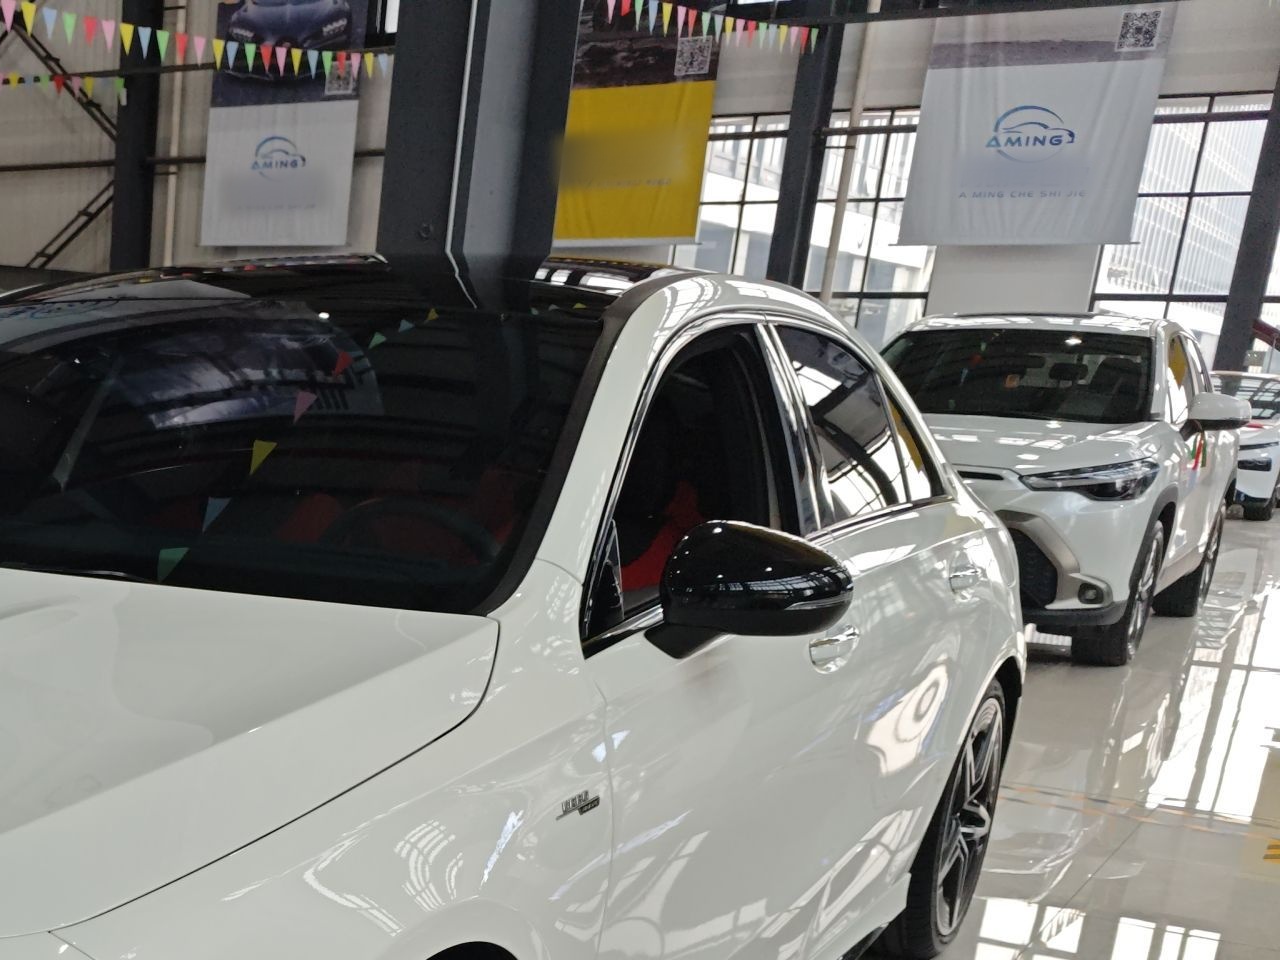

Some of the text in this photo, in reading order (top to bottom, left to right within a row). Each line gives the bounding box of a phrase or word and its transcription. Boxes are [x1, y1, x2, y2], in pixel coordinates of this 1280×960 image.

[985, 135, 1063, 148] AMING
[251, 160, 298, 170] AMING
[972, 190, 1005, 199] MING
[1010, 190, 1034, 198] CHE
[1040, 190, 1061, 198] SHI
